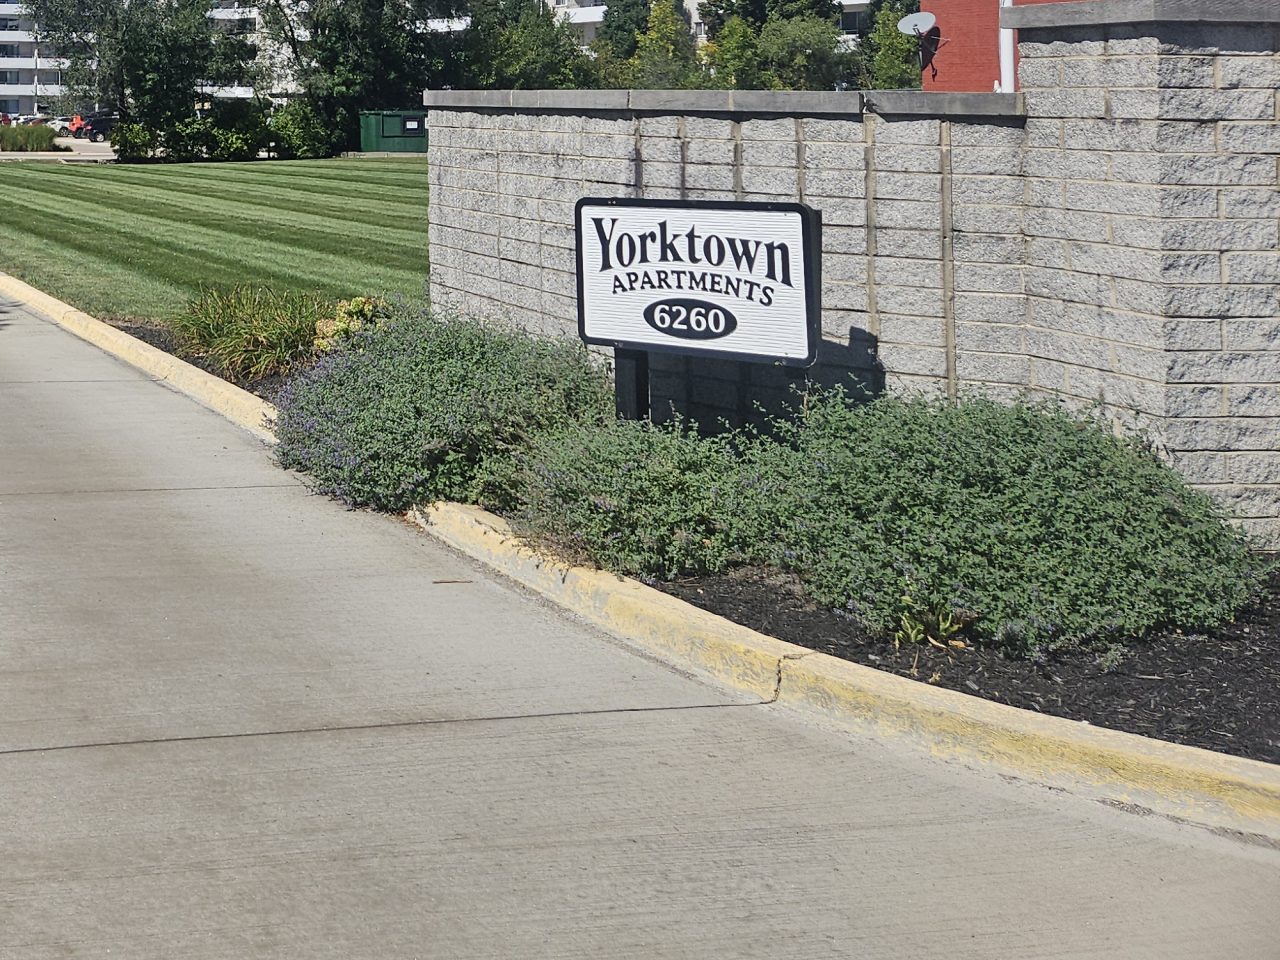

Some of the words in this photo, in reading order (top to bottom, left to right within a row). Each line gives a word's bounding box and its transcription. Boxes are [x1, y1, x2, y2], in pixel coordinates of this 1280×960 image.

[591, 217, 795, 289] Yorktown
[611, 270, 775, 307] APARTMENTS
[653, 304, 726, 333] 6260
